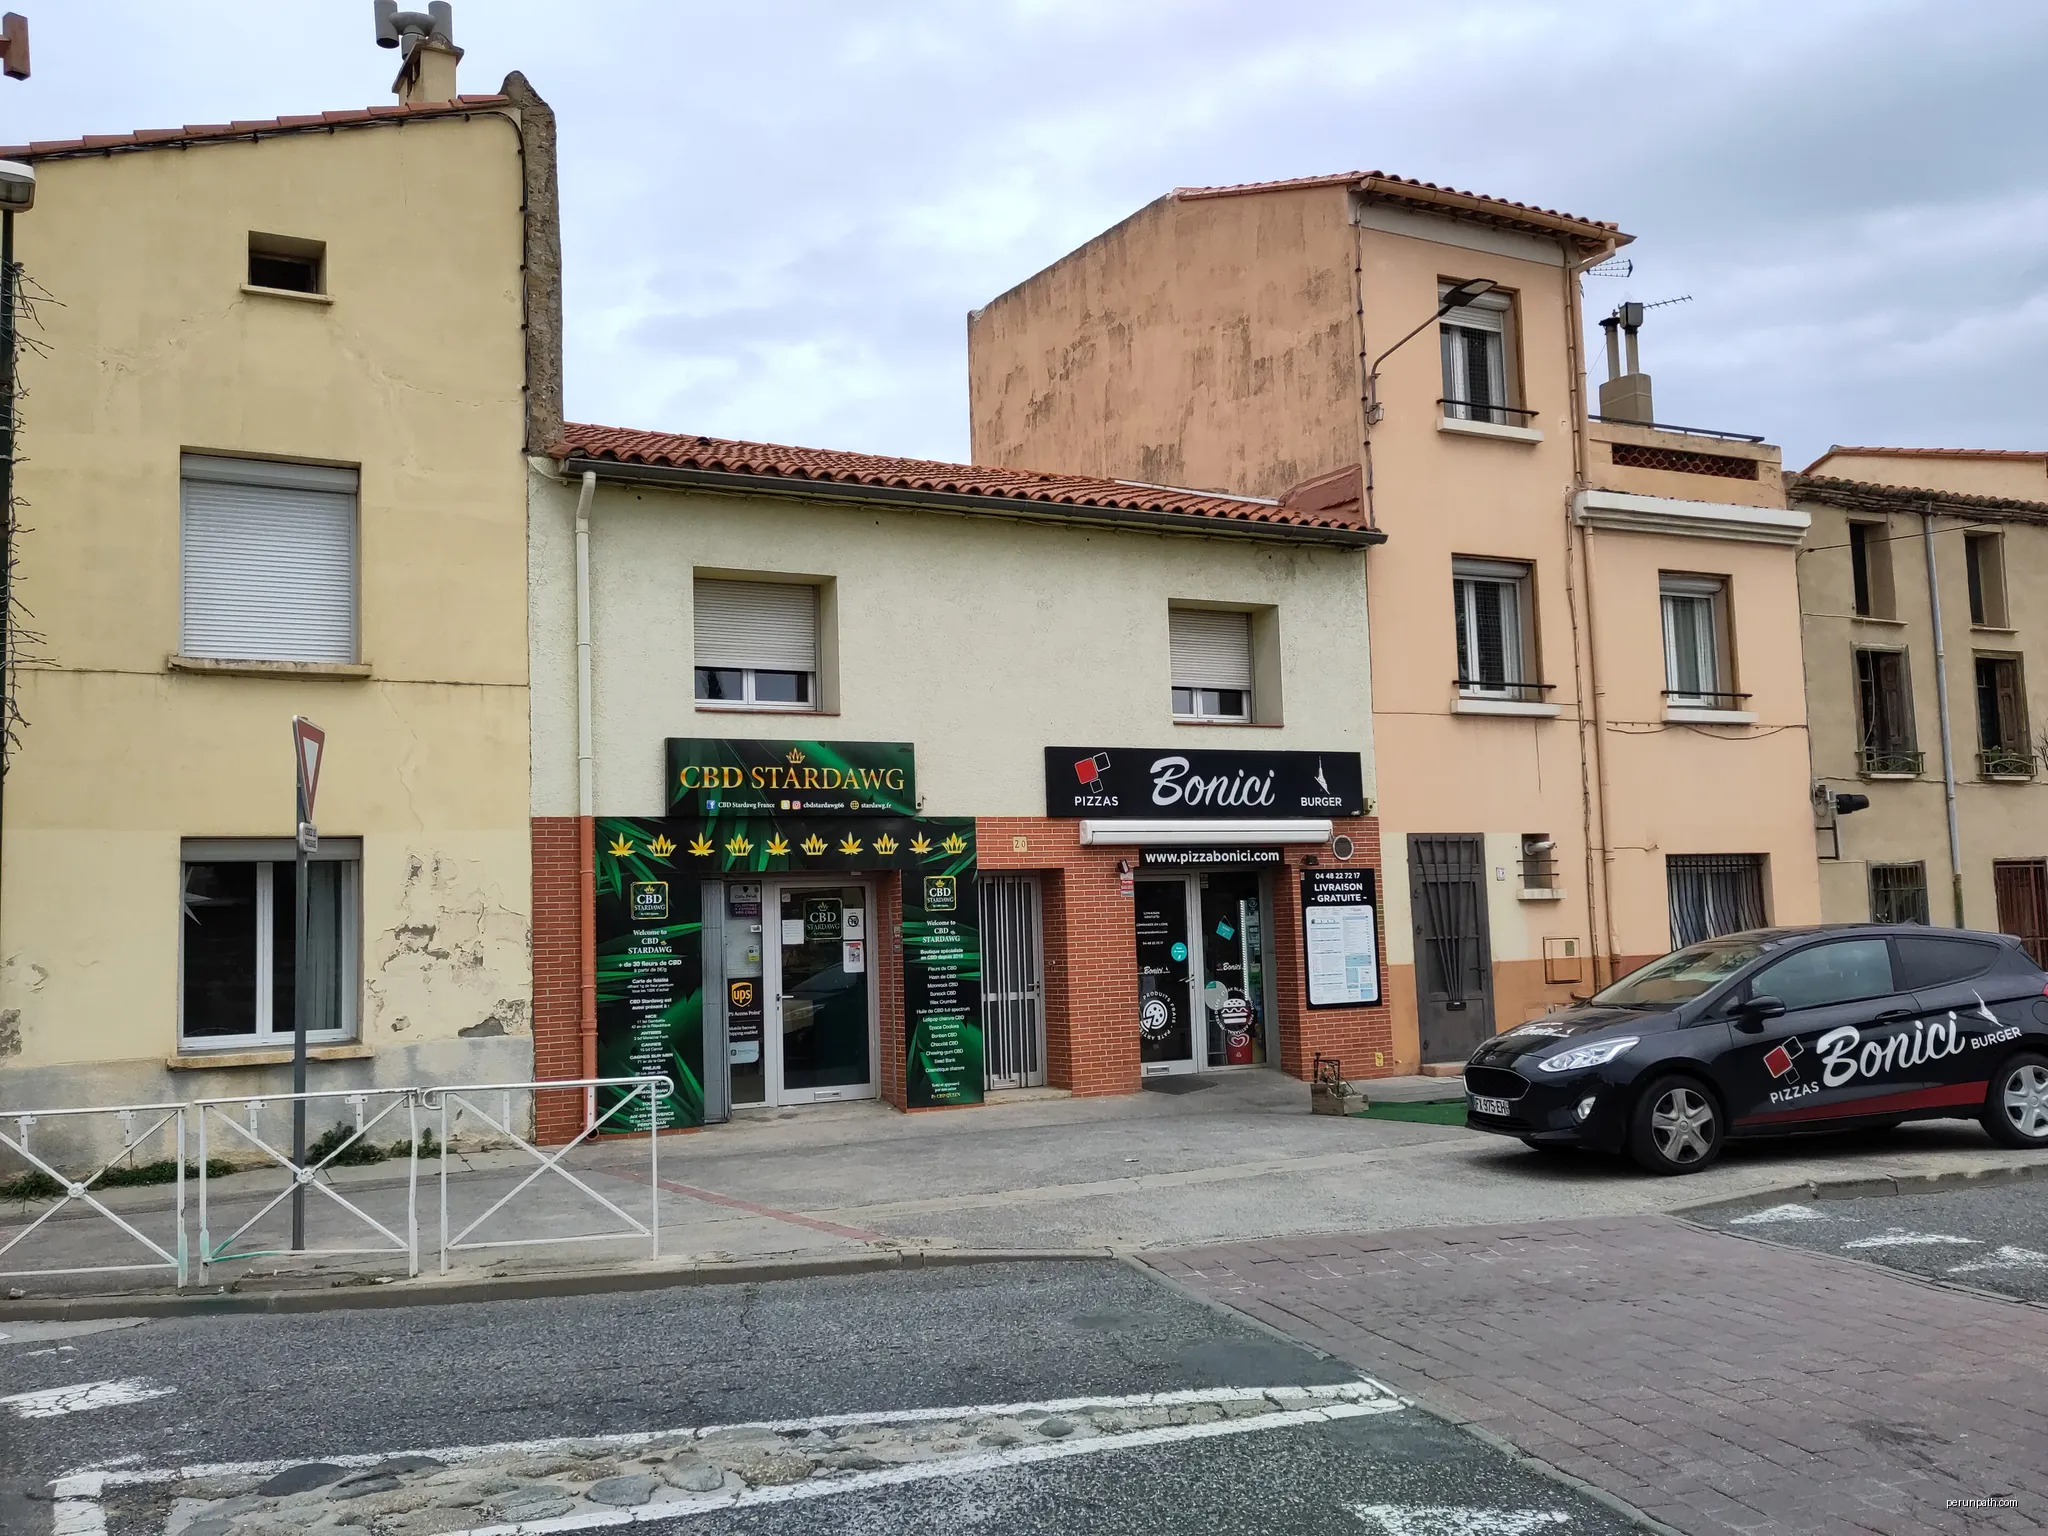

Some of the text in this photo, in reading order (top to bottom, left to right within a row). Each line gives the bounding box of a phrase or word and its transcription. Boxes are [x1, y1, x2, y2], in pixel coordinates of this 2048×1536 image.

[680, 766, 905, 790] CBD STARDAWG
[1149, 756, 1275, 807] Bonici
[718, 801, 775, 810] CBD Stardawg France
[803, 801, 845, 810] cbdstardawg66
[861, 802, 892, 810] stardawg.fr
[1074, 796, 1118, 807] PIZZAS
[1300, 796, 1342, 807] BURGER
[1014, 840, 1026, 848] 20
[1145, 850, 1280, 865] www.pizzabonici.com
[1314, 883, 1363, 891] LIVRAISON
[929, 888, 951, 897] CBD
[637, 894, 662, 904] CBD
[1317, 894, 1361, 902] GRATUITE
[810, 911, 836, 923] CBD
[628, 946, 672, 954] STARDAWG
[1144, 966, 1163, 974] Bonici
[1223, 962, 1241, 971] Bonici
[733, 990, 751, 1003] ups
[1143, 991, 1171, 1002] PRODUITS
[1971, 1026, 2022, 1050] BURGER
[1816, 1010, 1966, 1088] Bonici
[1770, 1081, 1819, 1104] PIZZAS
